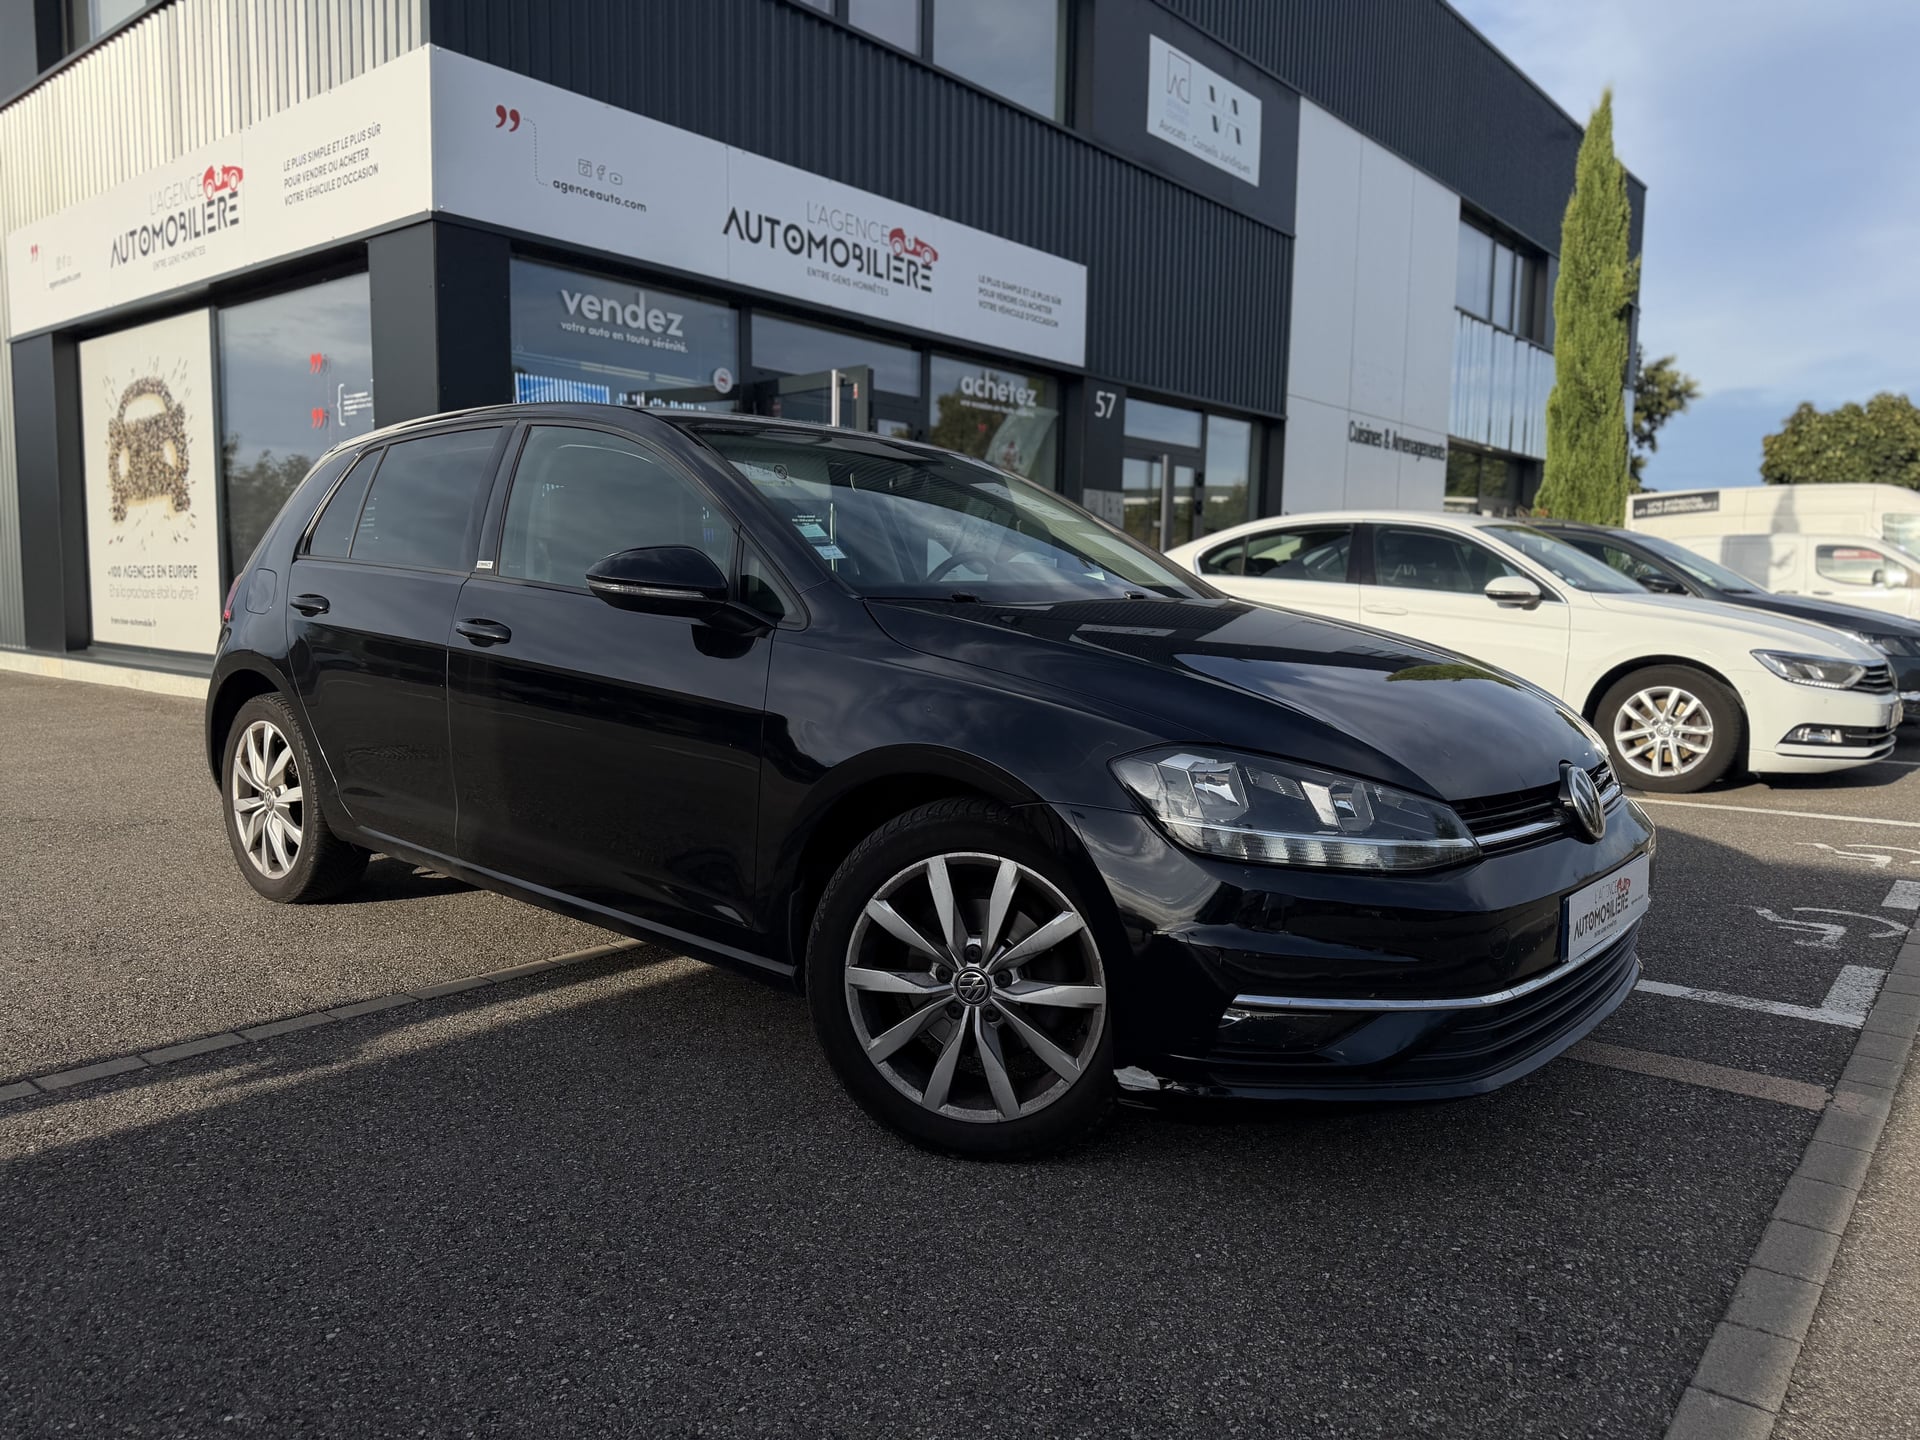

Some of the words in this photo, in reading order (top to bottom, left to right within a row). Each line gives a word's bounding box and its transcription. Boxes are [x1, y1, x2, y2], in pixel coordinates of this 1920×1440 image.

[283, 160, 291, 172] LE
[292, 153, 307, 168] PLUS
[308, 143, 332, 162] SIMPLE
[332, 140, 340, 153] ET
[341, 136, 349, 150] LE
[350, 130, 366, 146] PLUS
[284, 173, 301, 189] POUR
[302, 163, 327, 182] VENDRE
[328, 159, 338, 173] OU
[339, 147, 369, 169] ACHETER
[285, 190, 304, 206] VOTRE
[552, 179, 647, 212] agenceauto.com
[806, 200, 890, 247] L'AGENCE
[807, 266, 830, 281] ENTRE
[831, 273, 851, 287] GENS
[561, 289, 684, 337] vendez
[560, 321, 586, 334] votre
[588, 325, 610, 339] auto
[612, 331, 625, 342] en
[626, 333, 651, 346] toute
[961, 369, 1038, 408] achetez
[1094, 390, 1117, 419] 57
[1348, 420, 1382, 448] Cuisines
[123, 564, 155, 579] AGENCES
[157, 564, 167, 579] EN
[168, 564, 198, 579] EUROPE
